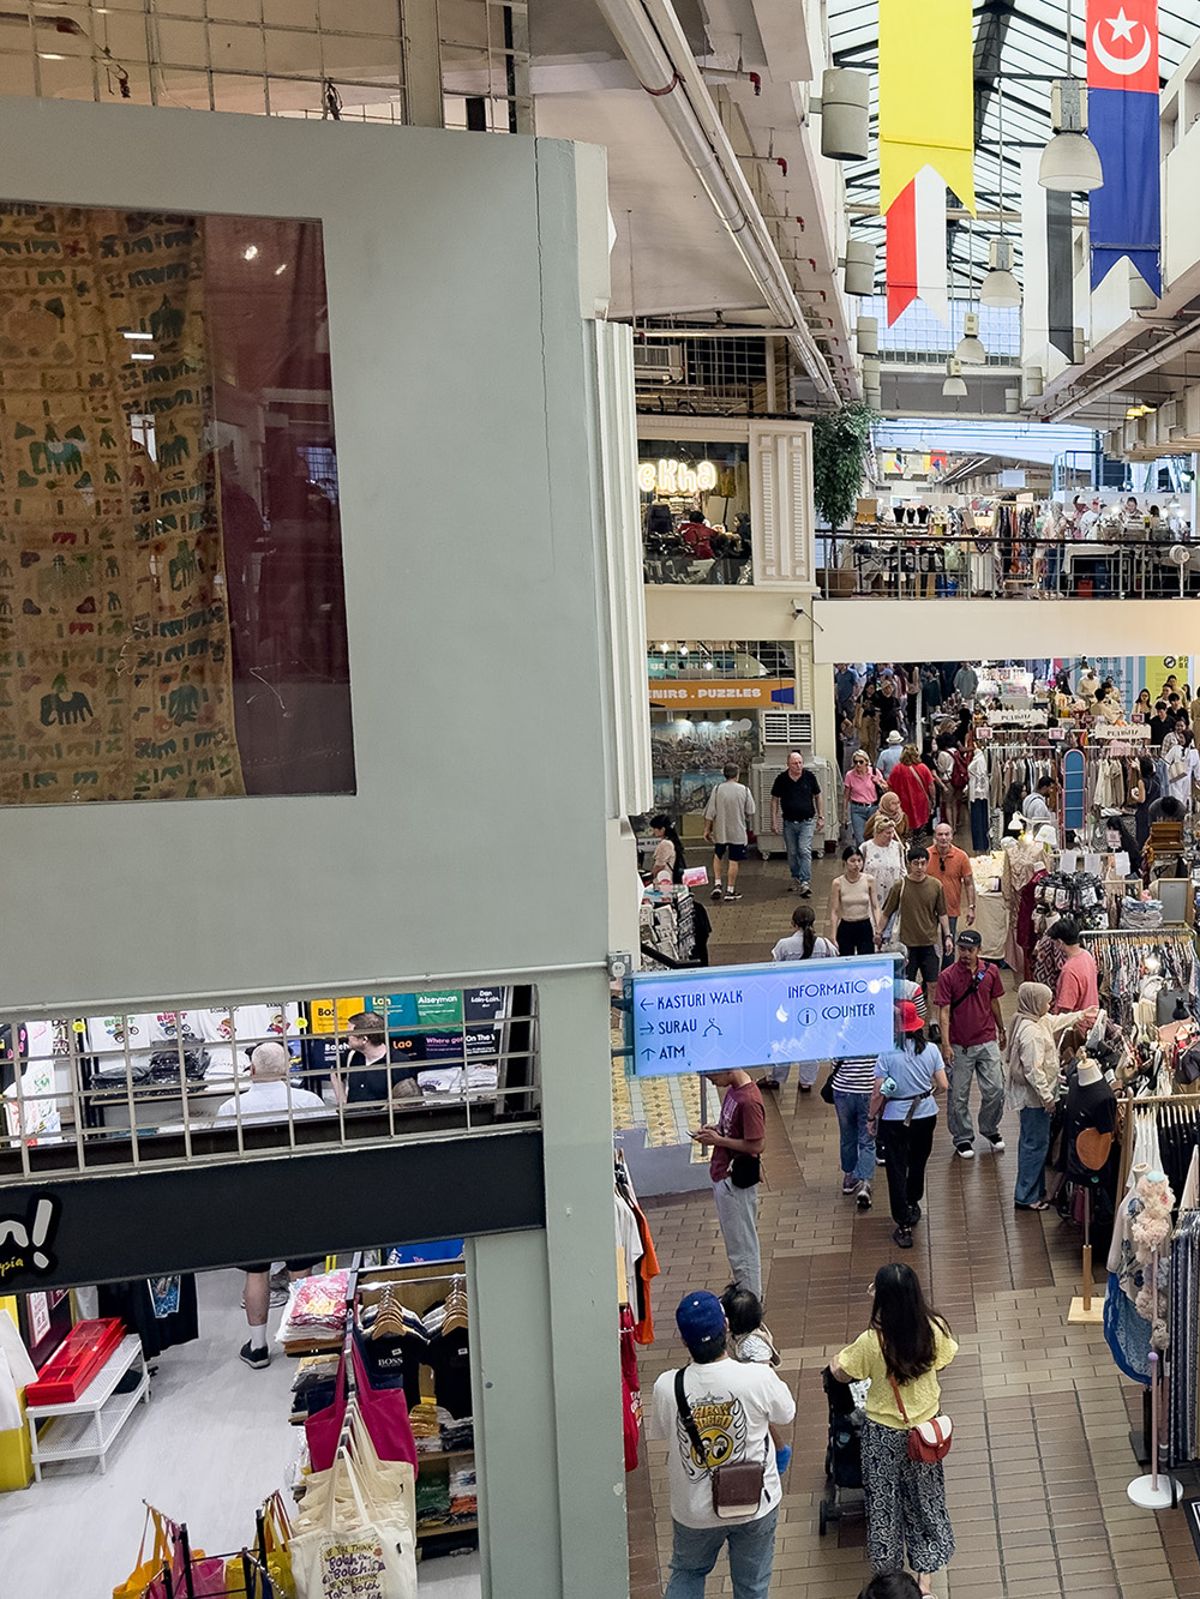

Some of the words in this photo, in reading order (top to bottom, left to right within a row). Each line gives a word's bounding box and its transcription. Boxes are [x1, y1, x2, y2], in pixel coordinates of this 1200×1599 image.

[698, 688, 762, 698] PUZZLES
[657, 994, 706, 1010] KASTURI
[709, 990, 743, 1005] WALK
[821, 1003, 876, 1021] COUNTER
[658, 1019, 697, 1035] SURAU
[659, 1046, 685, 1060] ATM
[378, 1358, 403, 1367] BOSS
